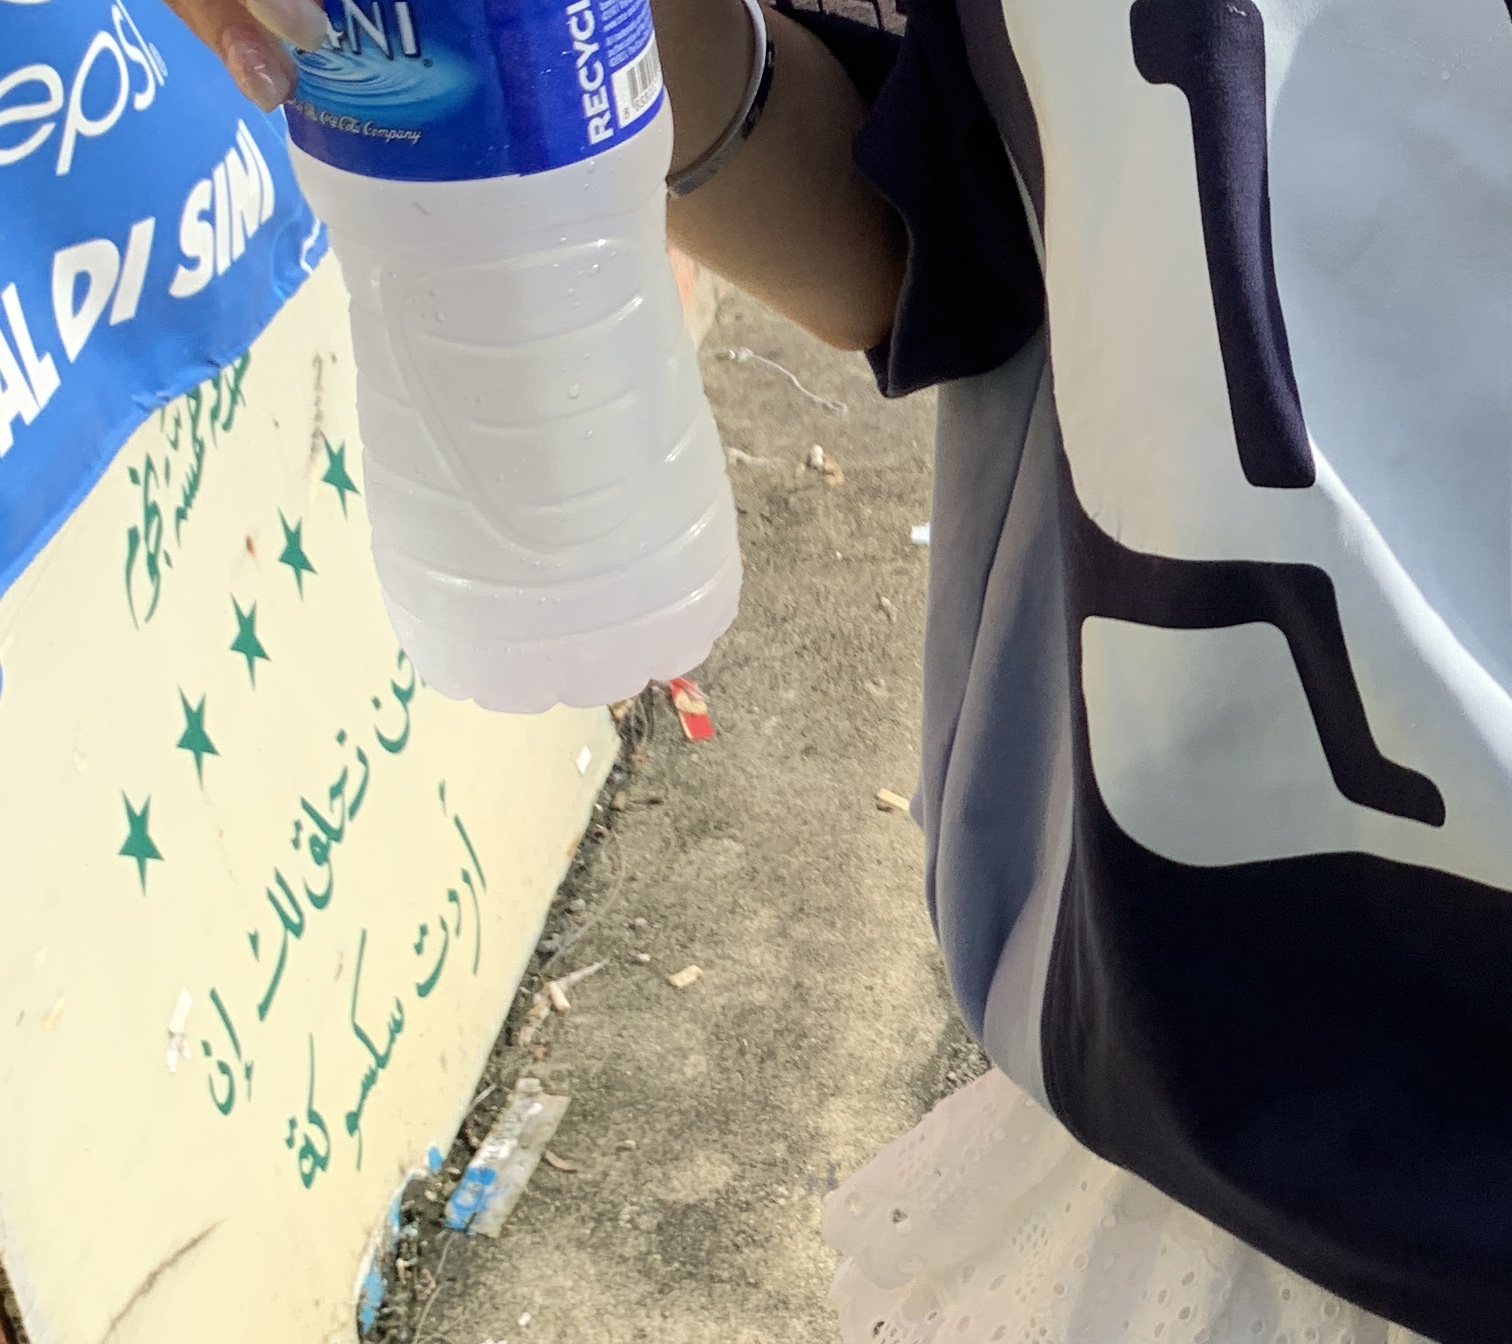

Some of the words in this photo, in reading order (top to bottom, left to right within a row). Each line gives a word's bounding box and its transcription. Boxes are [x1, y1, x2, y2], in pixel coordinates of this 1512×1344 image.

[363, 120, 421, 145] Company
[0, 281, 62, 456] AL
[52, 217, 156, 364] DI
[168, 118, 276, 299] SINI
[371, 647, 427, 754] حن
